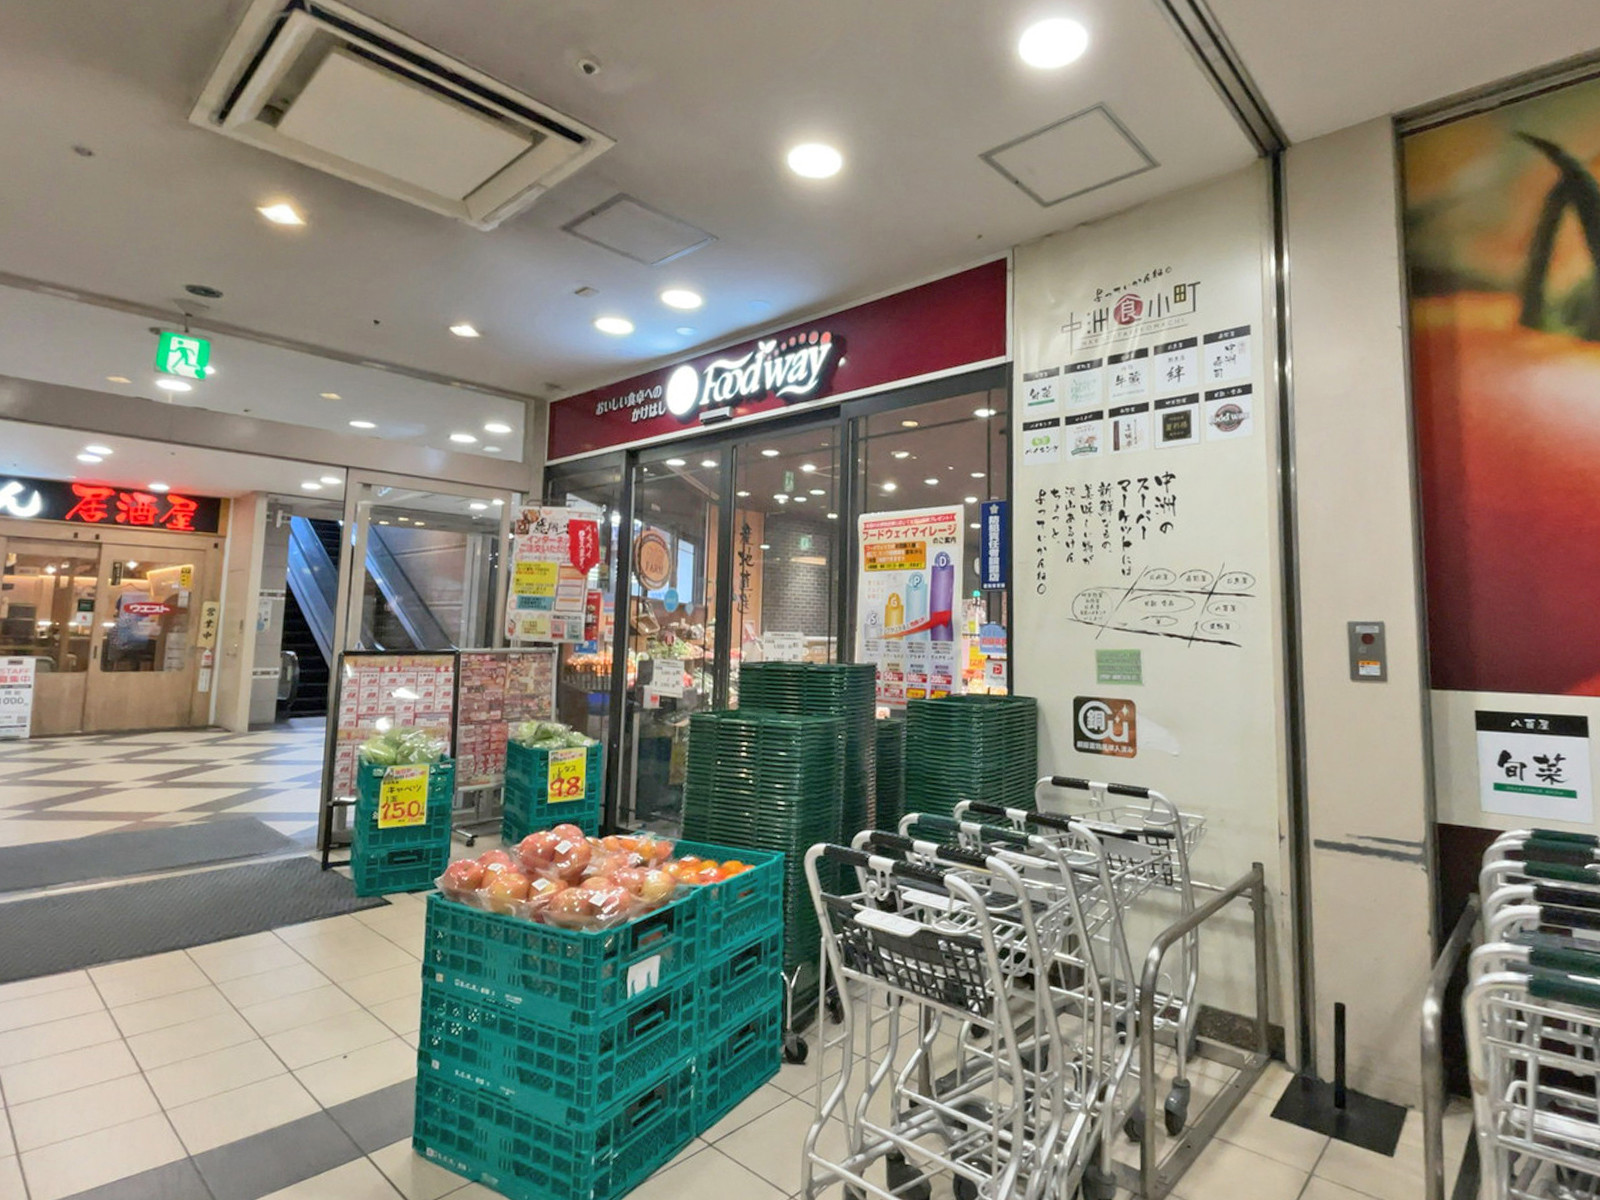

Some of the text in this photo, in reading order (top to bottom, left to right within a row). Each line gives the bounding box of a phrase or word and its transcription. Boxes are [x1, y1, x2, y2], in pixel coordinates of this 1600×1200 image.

[699, 342, 832, 405] Foodway
[595, 384, 662, 415] おいしい食卓への
[631, 402, 666, 423] かけはし
[65, 483, 199, 531] 居酒屋
[1136, 478, 1151, 540] スーパー
[1154, 471, 1177, 534] 中洲の
[862, 524, 957, 541] フードウェイマイレージ
[1117, 479, 1132, 576] マーケットには
[939, 556, 947, 566] D
[129, 604, 171, 613] ウエスト
[202, 606, 216, 640] 営業中
[1510, 718, 1550, 730] 八百屋
[1497, 749, 1567, 785] 旬菜
[550, 775, 580, 797] 98
[381, 800, 421, 820] 150
